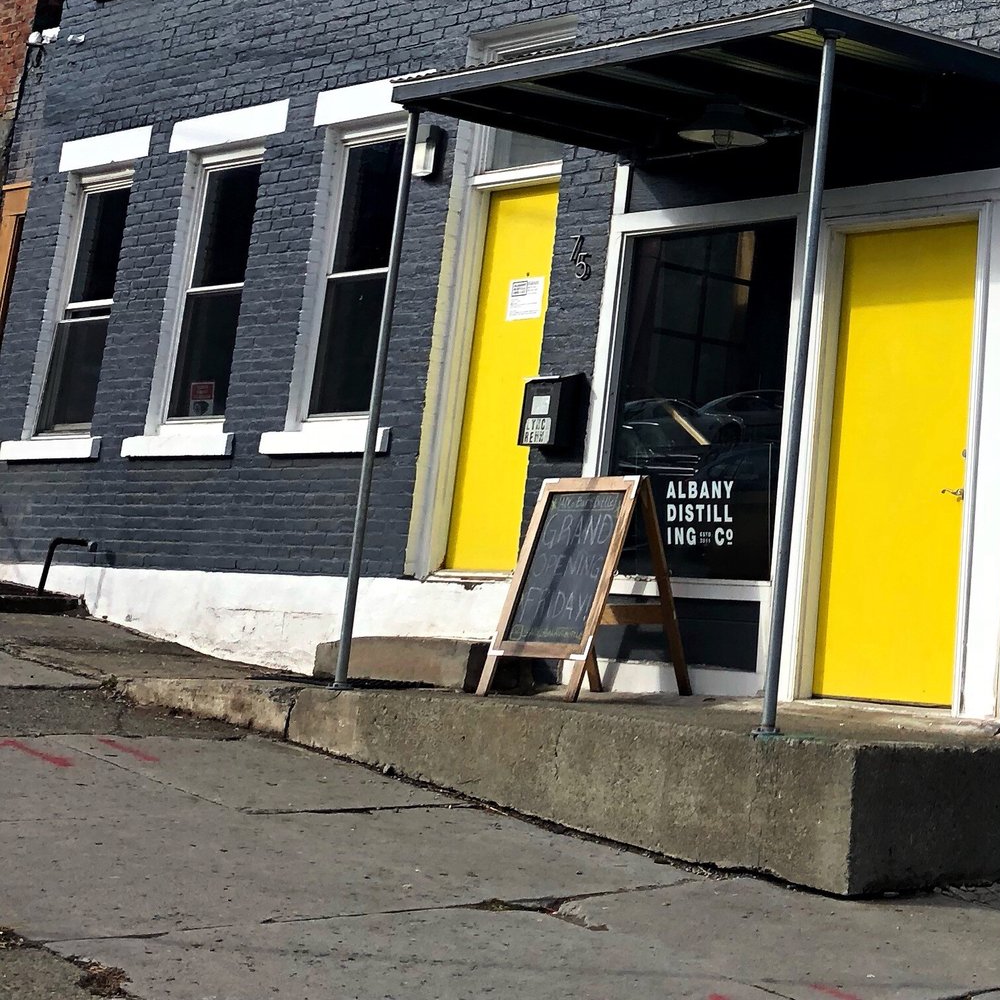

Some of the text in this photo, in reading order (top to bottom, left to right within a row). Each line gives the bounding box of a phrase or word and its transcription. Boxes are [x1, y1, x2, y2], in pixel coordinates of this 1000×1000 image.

[569, 235, 588, 279] 75
[666, 480, 734, 499] ALBANY
[667, 503, 733, 522] DISTILL
[542, 513, 614, 549] GRAND
[667, 527, 697, 545] ING
[534, 554, 605, 578] OPENING
